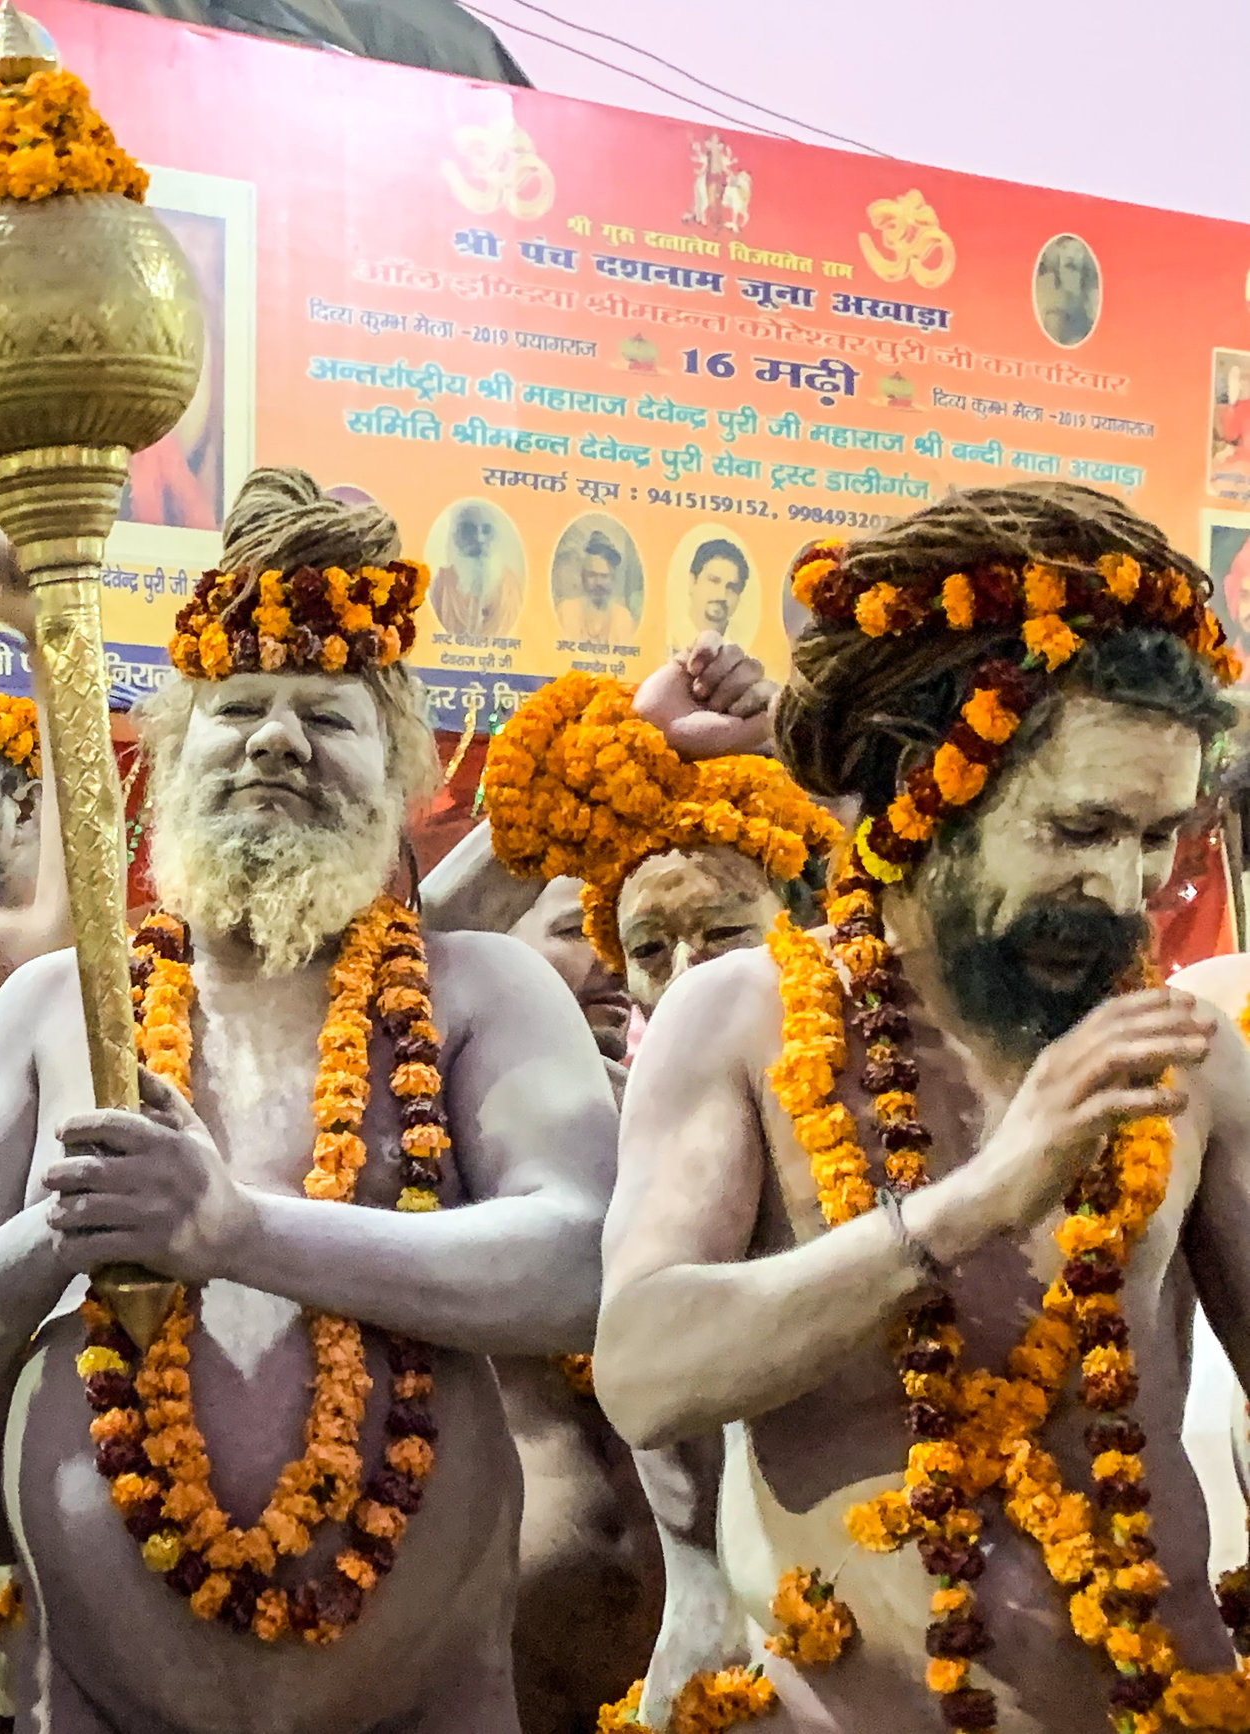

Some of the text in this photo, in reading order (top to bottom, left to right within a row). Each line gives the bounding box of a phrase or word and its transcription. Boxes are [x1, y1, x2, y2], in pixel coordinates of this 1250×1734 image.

[567, 216, 591, 236] श्री
[454, 228, 952, 331] श्री पंच दशनाम जूना अखाड़ा
[309, 298, 598, 357] दिव्य कुम्भ मेला -2019 प्रयागराज
[585, 293, 727, 333] श्रीमहन्त
[738, 316, 868, 352] कोटेश्वर
[873, 337, 926, 365] पुरी
[934, 346, 972, 370] जी
[981, 355, 1024, 378] का
[683, 349, 862, 408] 16 मढ़ी
[346, 405, 442, 442] समिति
[452, 416, 570, 457] श्रीमहन्त
[579, 432, 651, 468] देवेन्द्र
[661, 444, 702, 481] पुरी
[712, 449, 762, 479] सेवा
[771, 461, 817, 491] ट्रस्ट
[478, 370, 512, 401] श्री
[523, 383, 627, 417] महाराज
[636, 393, 707, 429] देवेन्द्र
[717, 405, 757, 442] पुरी
[767, 411, 801, 440] जी
[809, 423, 904, 453] महाराज
[913, 431, 943, 459] श्री
[1011, 451, 1060, 475] माता
[481, 467, 568, 494] सम्पर्क
[576, 477, 620, 503] सूत्र
[647, 487, 777, 519] 9415159152,
[143, 567, 165, 603] पुरी
[168, 569, 188, 595] जी
[461, 680, 488, 711] के
[493, 680, 534, 713] नि
